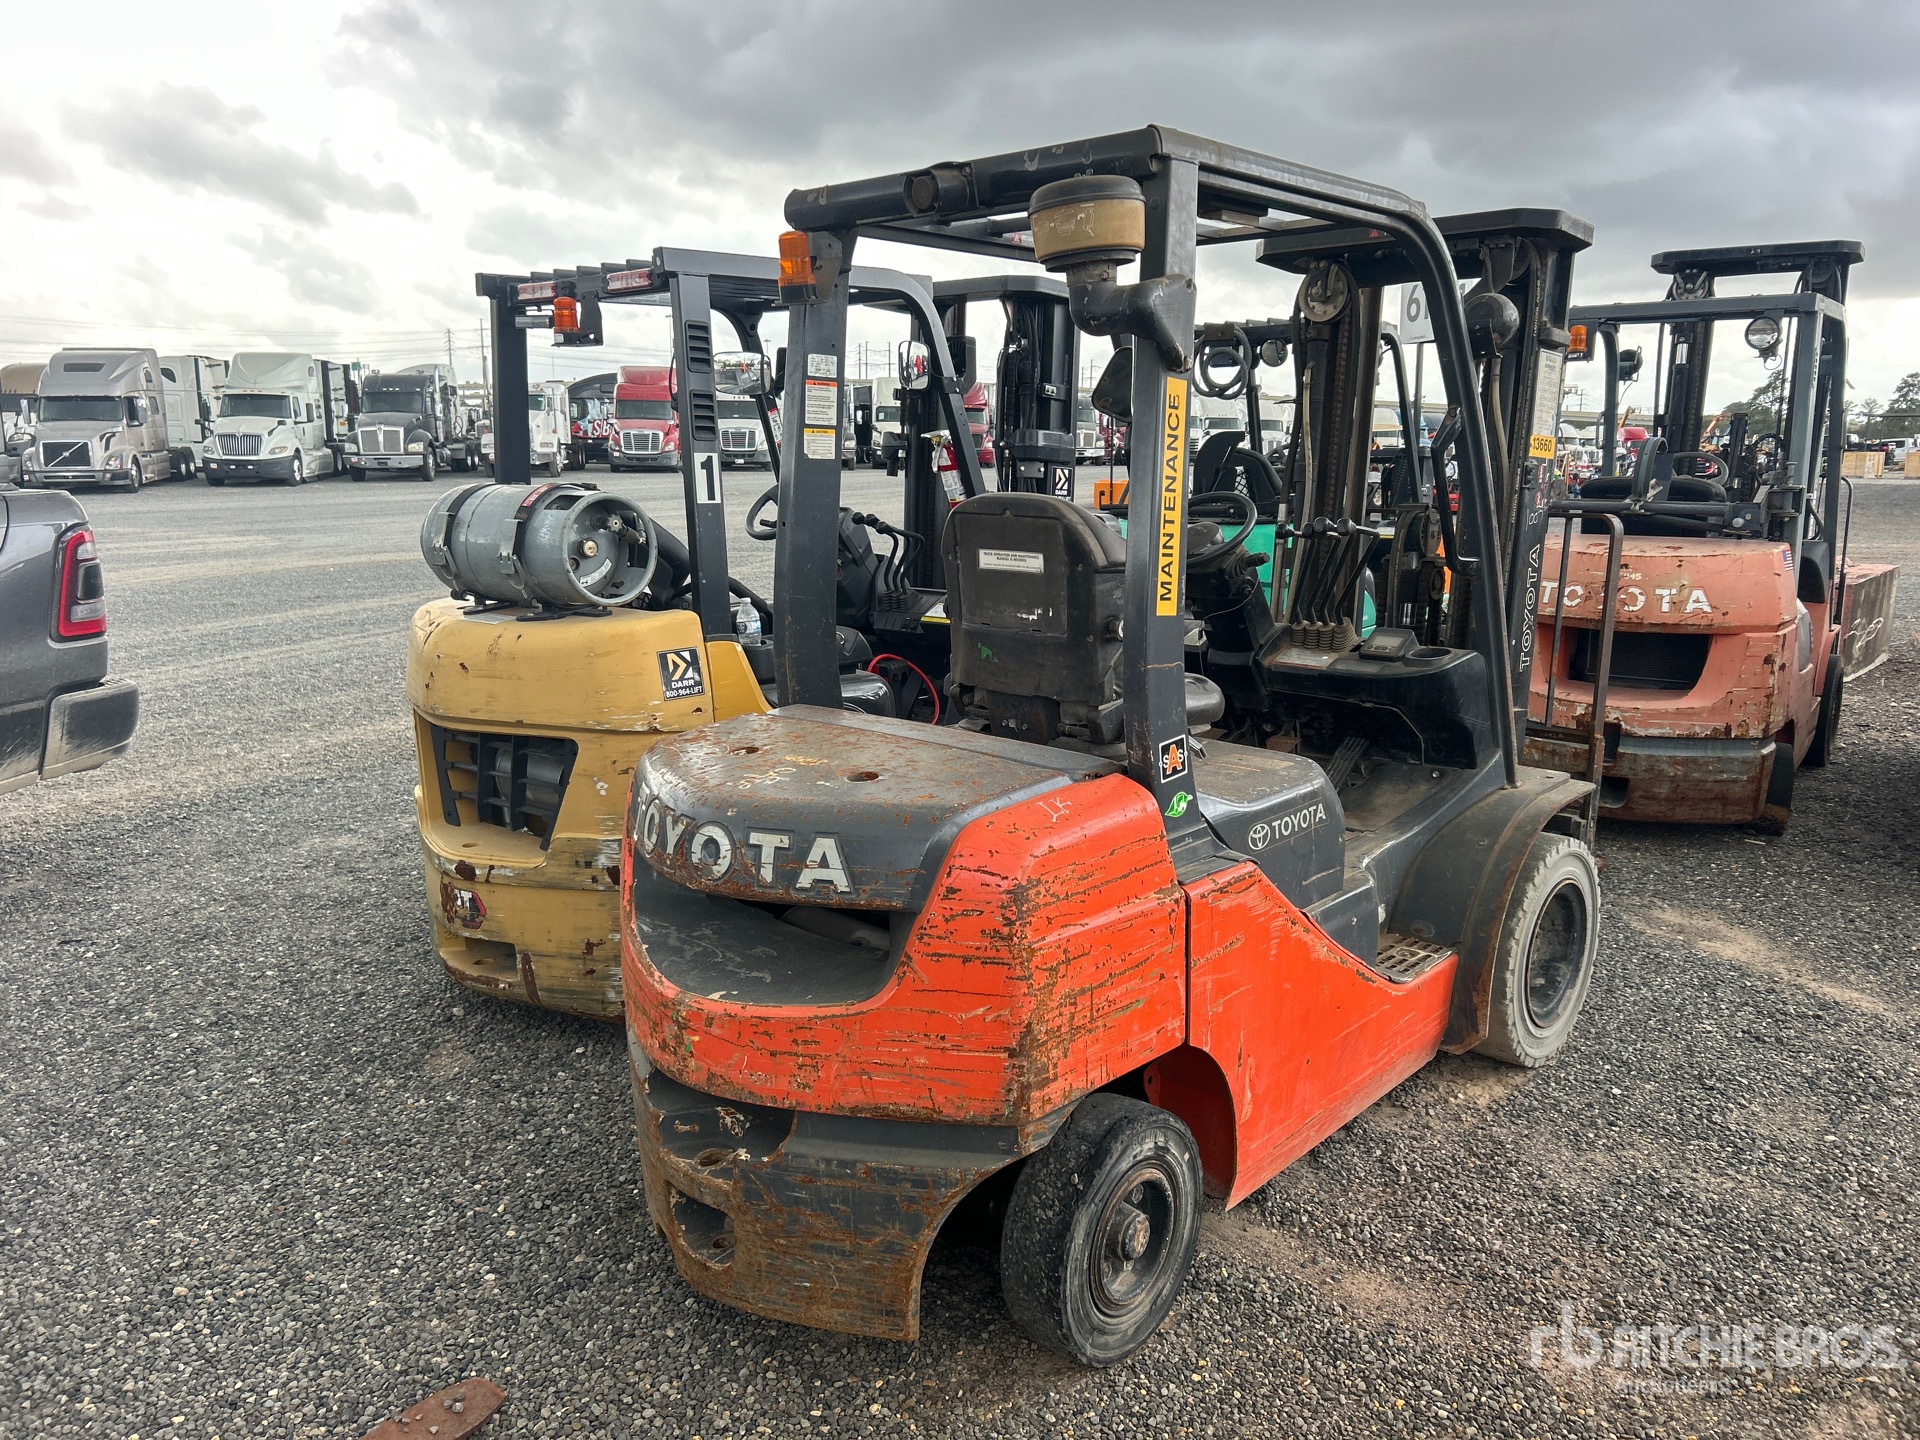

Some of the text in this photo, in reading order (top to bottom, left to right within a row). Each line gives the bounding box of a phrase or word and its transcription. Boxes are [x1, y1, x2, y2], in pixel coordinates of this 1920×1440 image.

[700, 455, 716, 501] 1
[1160, 393, 1180, 602] MAINTENANCE
[1519, 543, 1541, 673] TOYOTA
[1541, 580, 1713, 614] TOOTA
[665, 686, 703, 698] 800-964-LIFT
[671, 679, 695, 689] DARR
[1163, 744, 1184, 775] SAS
[633, 781, 852, 893] TOYOTA
[1271, 803, 1327, 840] TOYOTA
